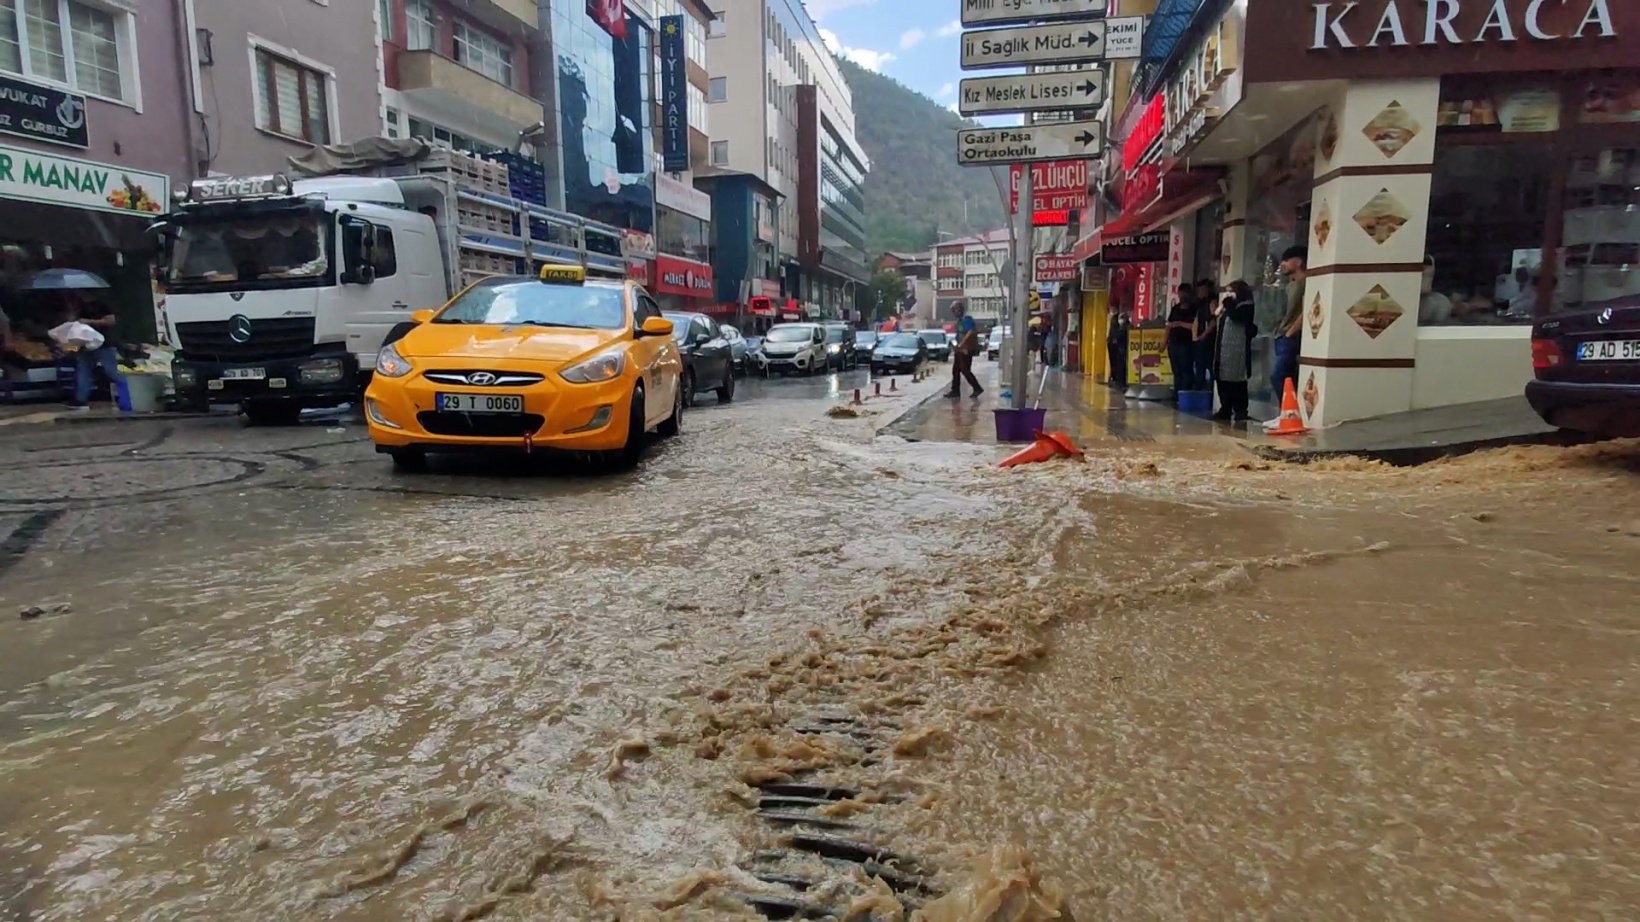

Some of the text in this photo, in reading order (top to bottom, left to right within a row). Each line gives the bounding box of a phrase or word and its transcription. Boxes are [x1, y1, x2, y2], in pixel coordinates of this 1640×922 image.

[1310, 0, 1617, 49] KARACA
[981, 37, 1029, 57] Sağlık
[1035, 32, 1075, 51] Müd.
[965, 82, 1073, 103] Kız Meslek Lisesi
[965, 132, 1031, 145] Gazi Paşa
[964, 146, 1037, 159] Ortaokulu
[23, 157, 109, 195] MANAV
[1012, 161, 1086, 192] GZLÜKÇÜ
[1582, 343, 1595, 358] 29
[1599, 342, 1616, 358] AD
[444, 395, 520, 410] 29 T 0060
